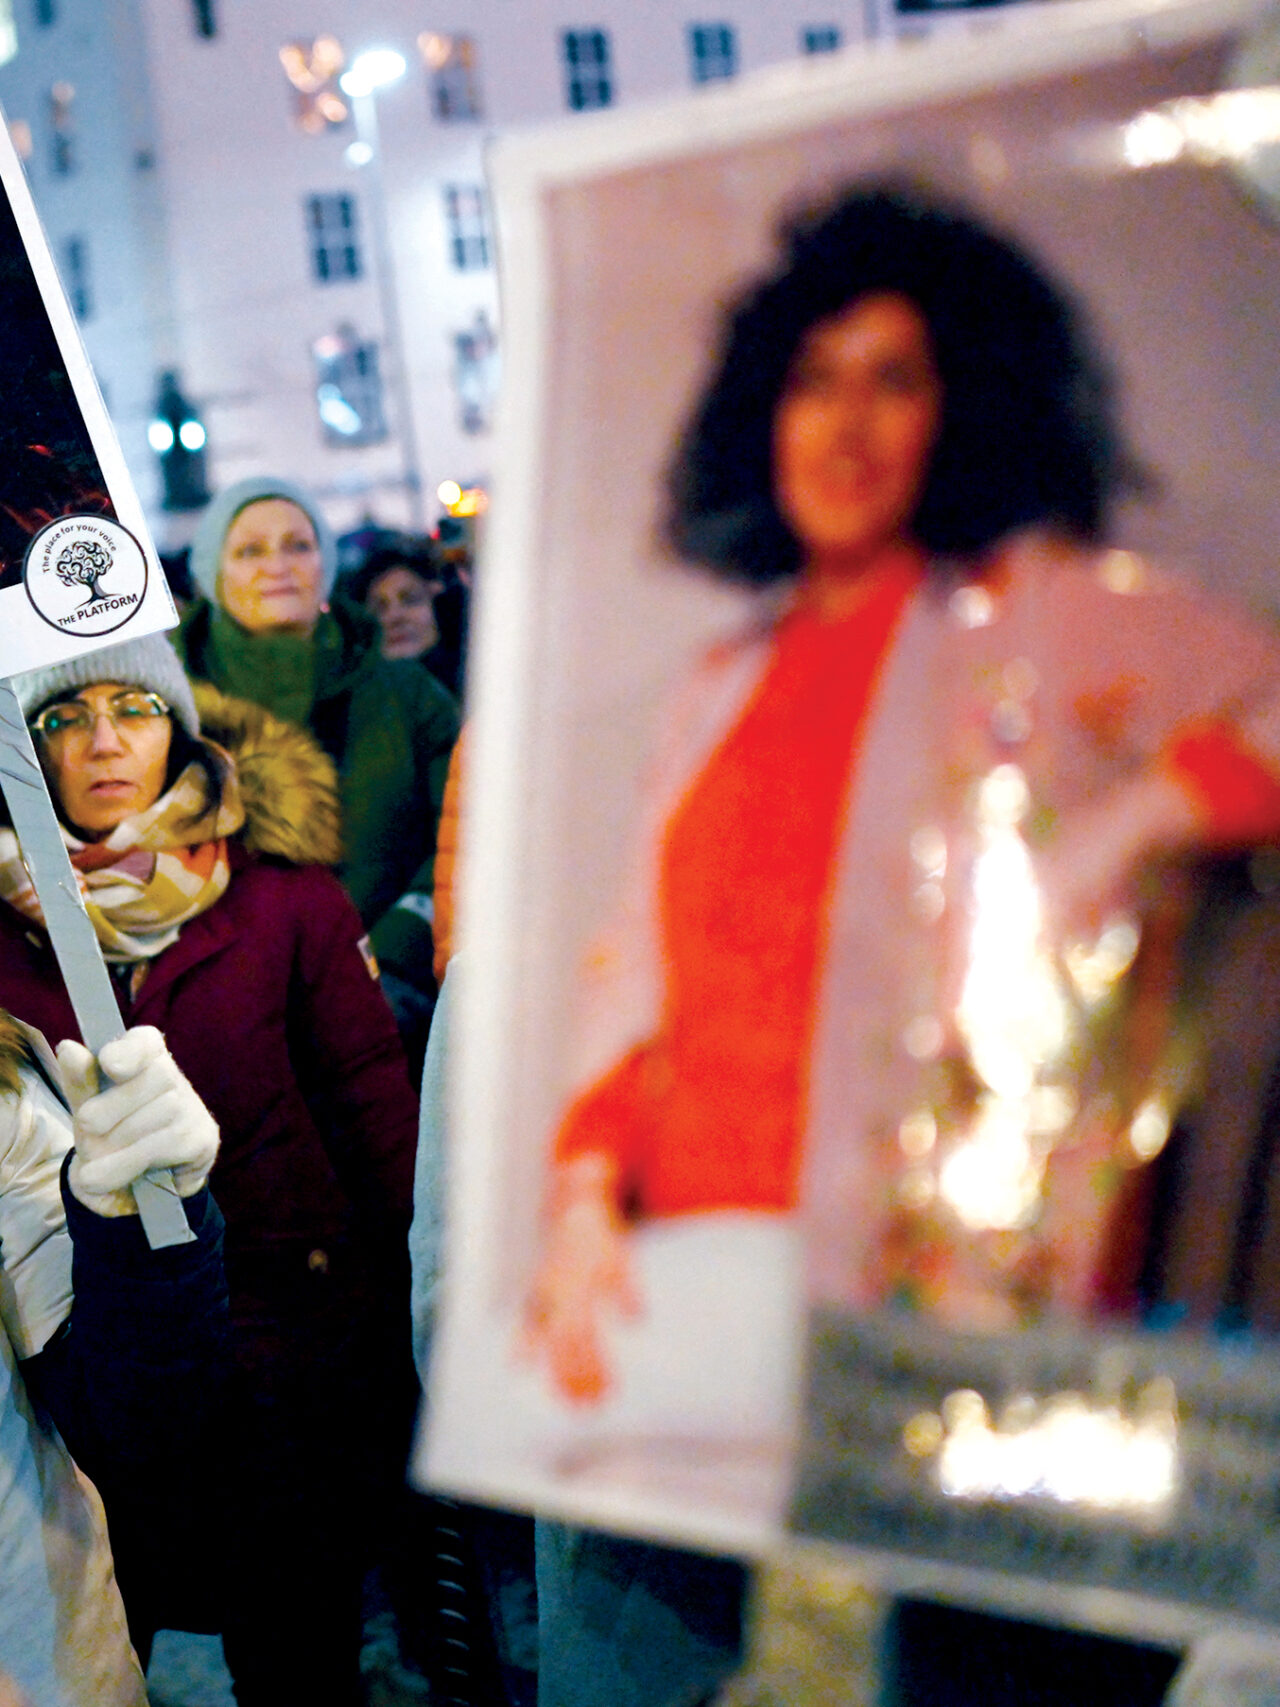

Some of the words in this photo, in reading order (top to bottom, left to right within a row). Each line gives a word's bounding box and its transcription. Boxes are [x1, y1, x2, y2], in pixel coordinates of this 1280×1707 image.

[60, 524, 74, 535] for
[76, 524, 98, 533] your
[44, 533, 62, 554] place
[99, 530, 117, 552] voice
[41, 556, 50, 573] The
[57, 615, 76, 627] THE
[77, 594, 138, 621] PLATFORM
